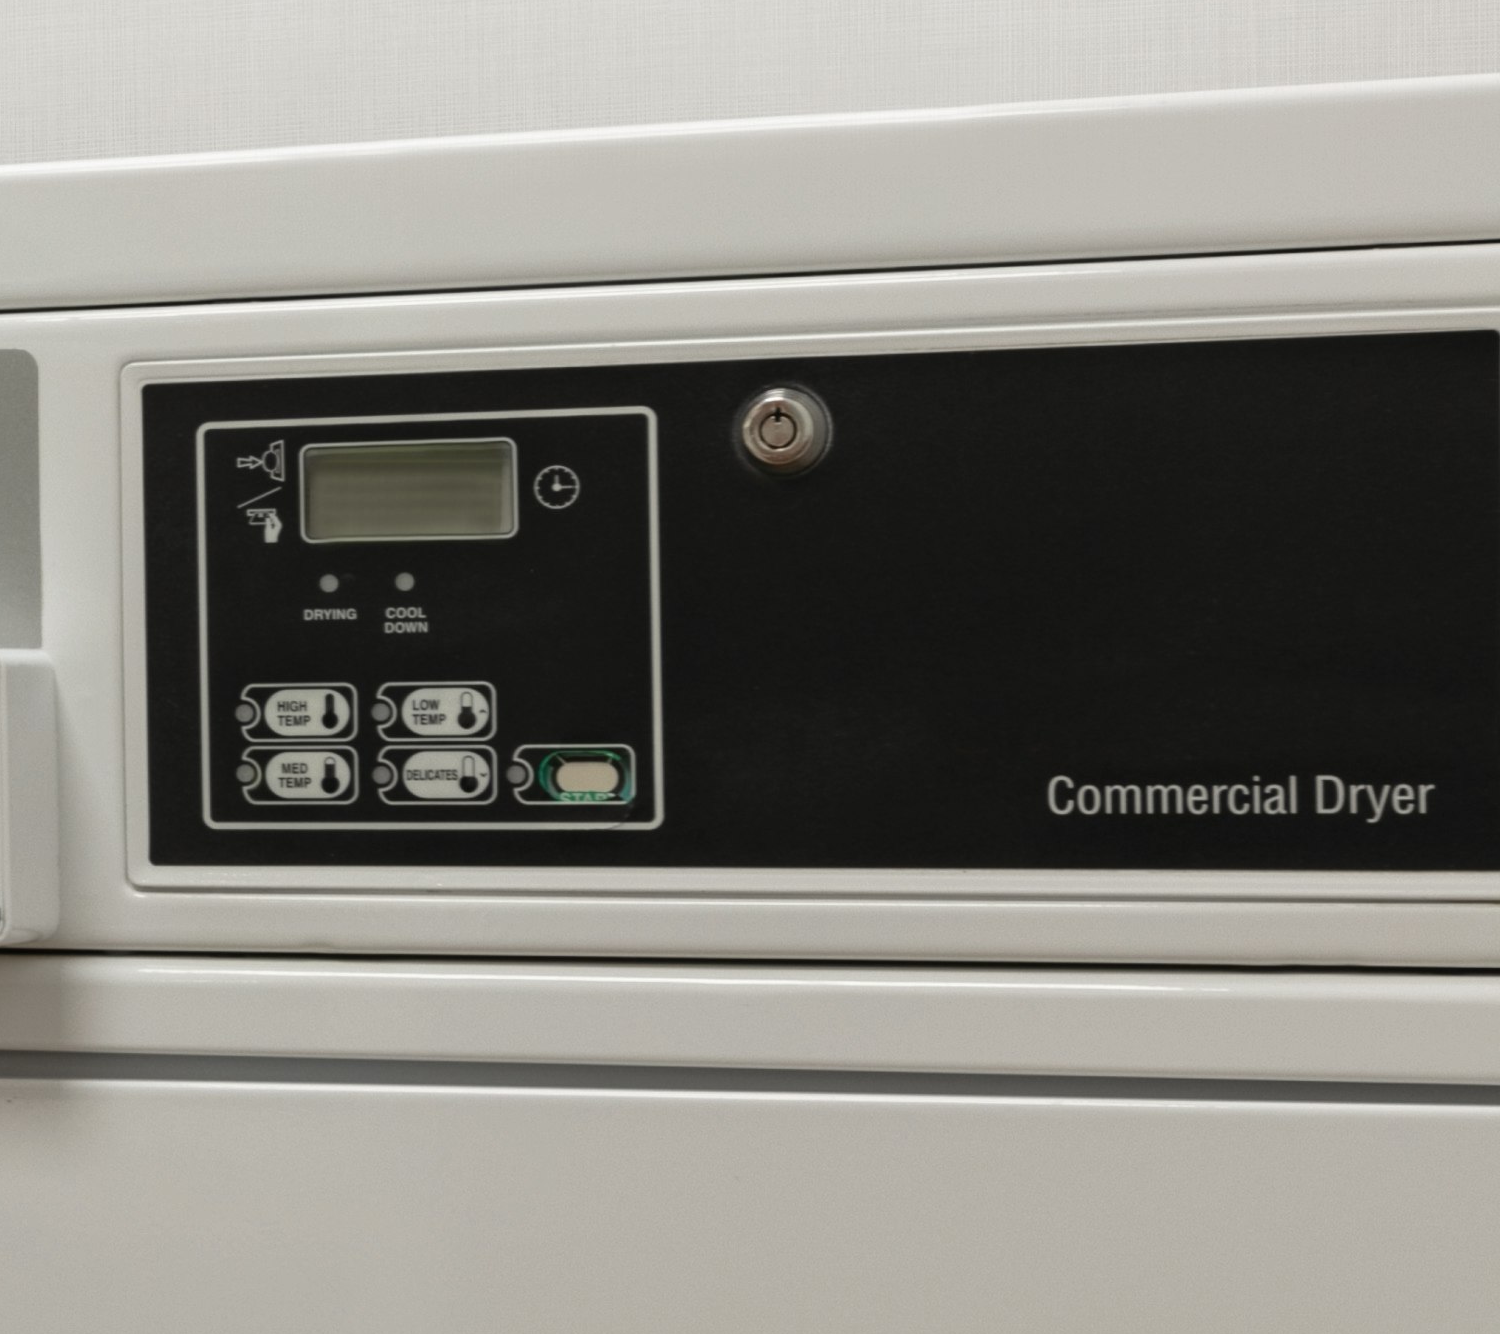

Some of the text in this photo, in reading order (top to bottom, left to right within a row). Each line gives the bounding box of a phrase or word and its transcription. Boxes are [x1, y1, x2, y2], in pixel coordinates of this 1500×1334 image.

[303, 609, 358, 622] DRYING
[385, 606, 426, 619] COOL
[384, 621, 428, 634] DOWN
[277, 701, 308, 713] HIGH
[412, 699, 440, 711] LOW
[277, 715, 311, 727] TEMP
[412, 713, 446, 725] TEMP
[282, 763, 308, 774] MED
[406, 769, 458, 781] DELICATES
[278, 777, 312, 788] TEMP
[1047, 774, 1436, 824] Commercial Dryer
